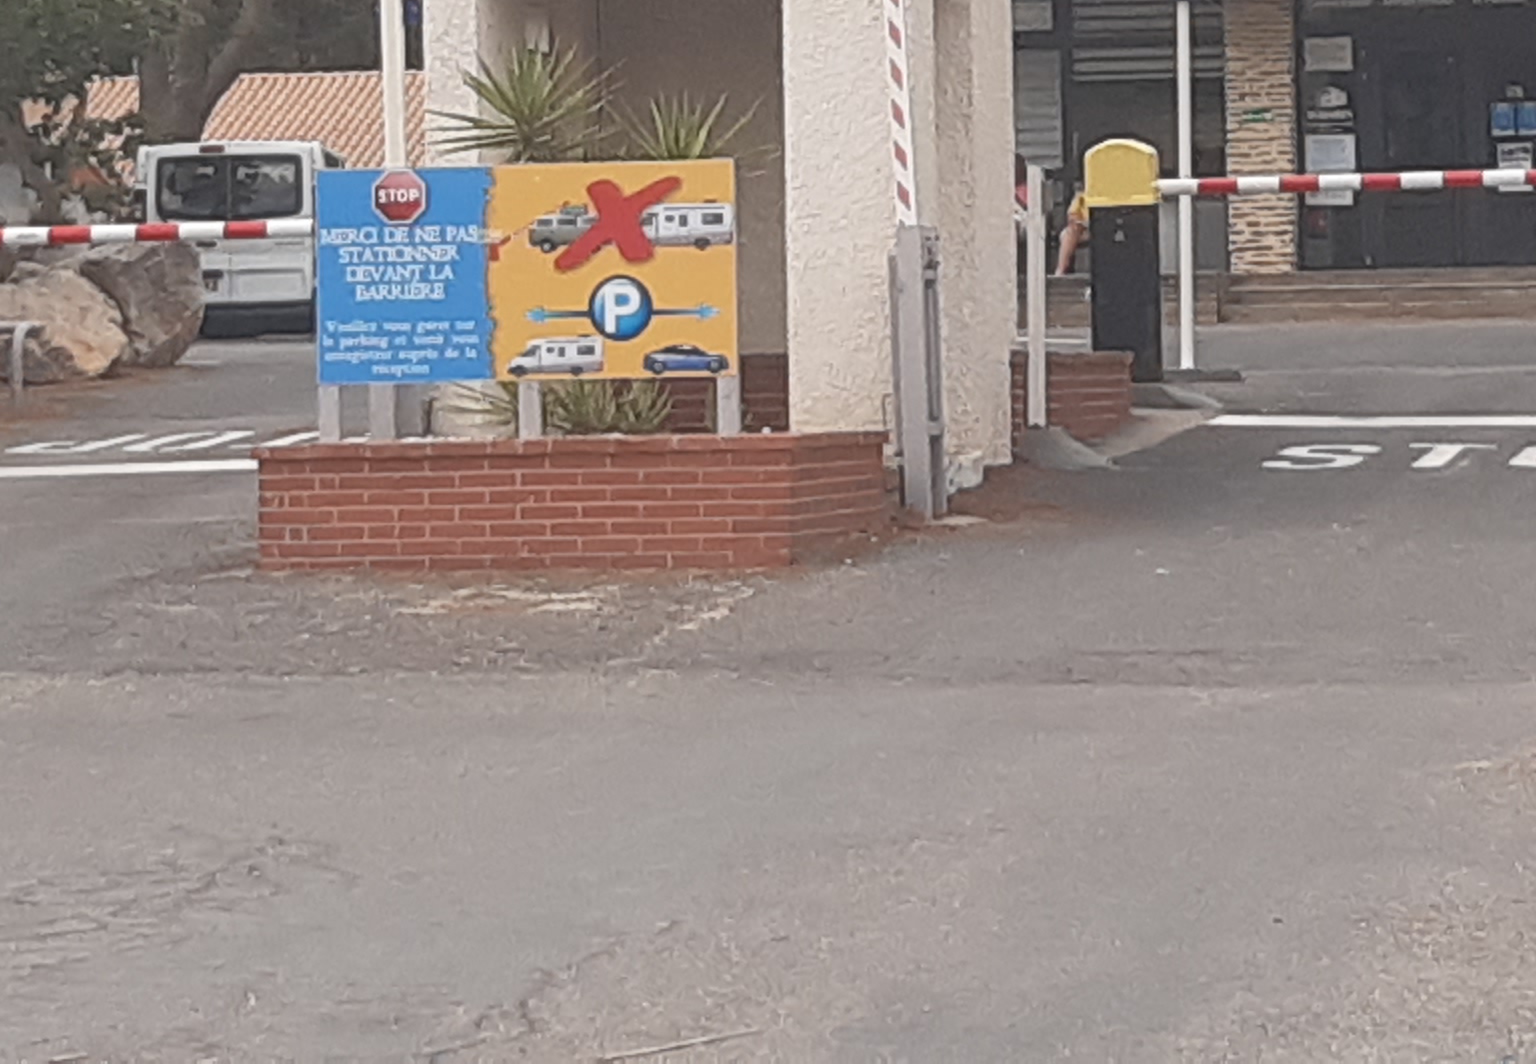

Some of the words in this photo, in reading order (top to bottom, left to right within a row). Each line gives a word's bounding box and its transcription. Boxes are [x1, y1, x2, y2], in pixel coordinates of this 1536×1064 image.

[378, 188, 420, 204] STOP
[320, 226, 379, 246] MERCI
[384, 226, 410, 244] DE
[415, 225, 442, 244] NE
[446, 224, 478, 244] PAS
[338, 245, 461, 264] STATIONNER
[346, 264, 424, 282] DEVANT
[429, 263, 456, 280] LA
[604, 280, 641, 334] P
